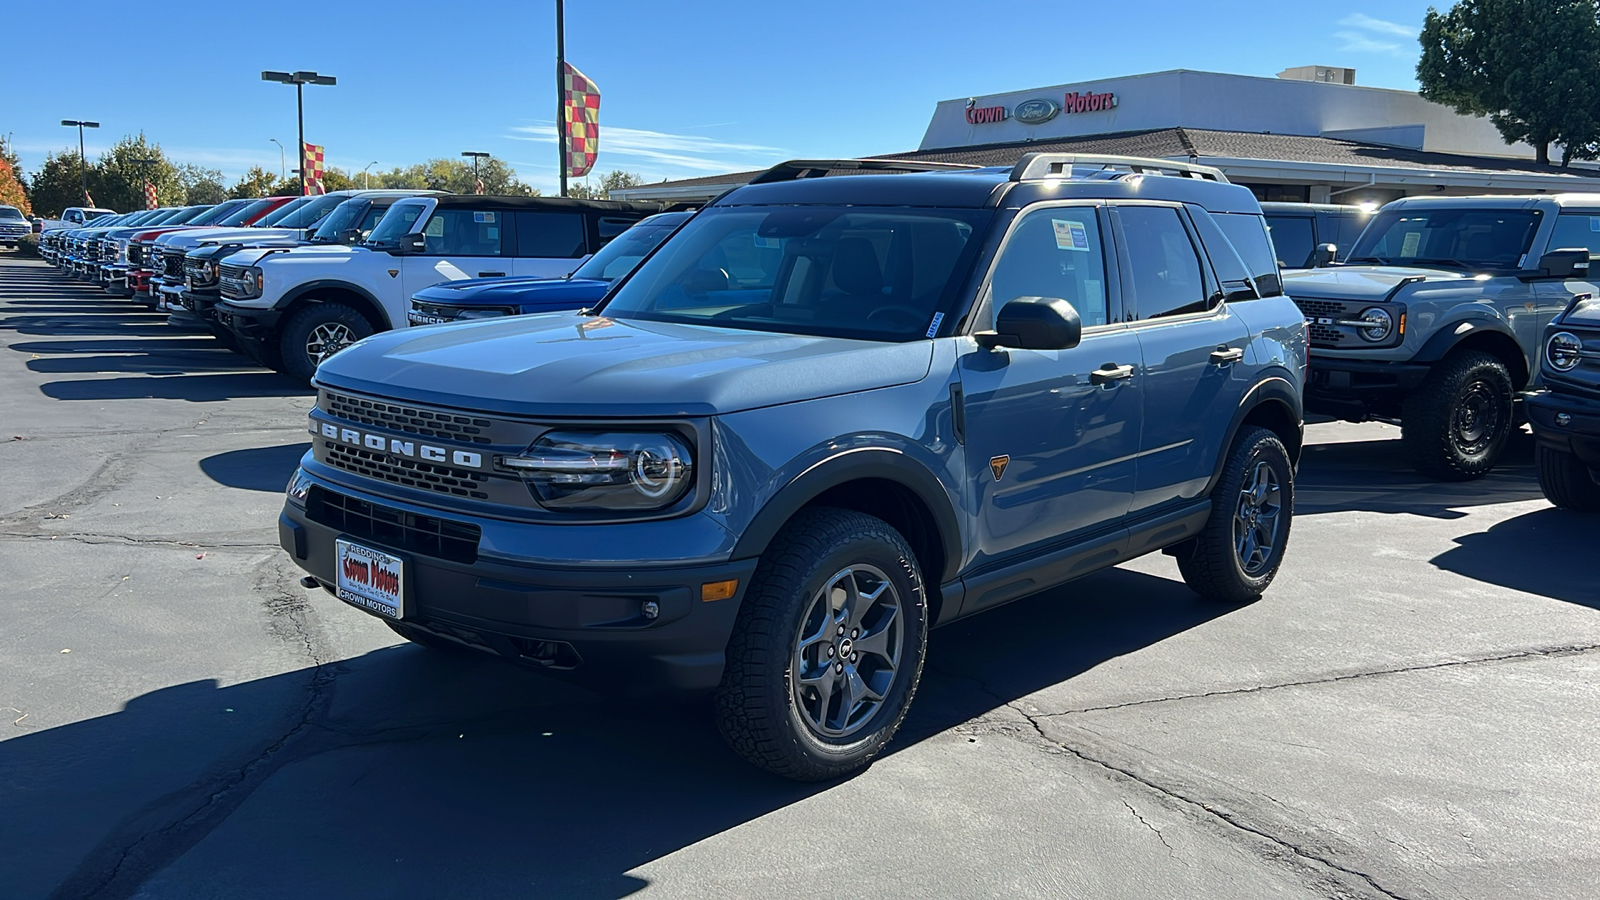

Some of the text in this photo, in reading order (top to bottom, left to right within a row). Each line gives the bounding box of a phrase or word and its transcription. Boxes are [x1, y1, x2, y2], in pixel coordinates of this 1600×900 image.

[966, 91, 1114, 124] Crown Ford Motors
[409, 314, 444, 324] BRONCO
[322, 422, 482, 468] BRONCO
[350, 545, 385, 562] REDDING
[342, 557, 399, 597] Crown Motors
[340, 589, 396, 617] CROWN MOTORS
